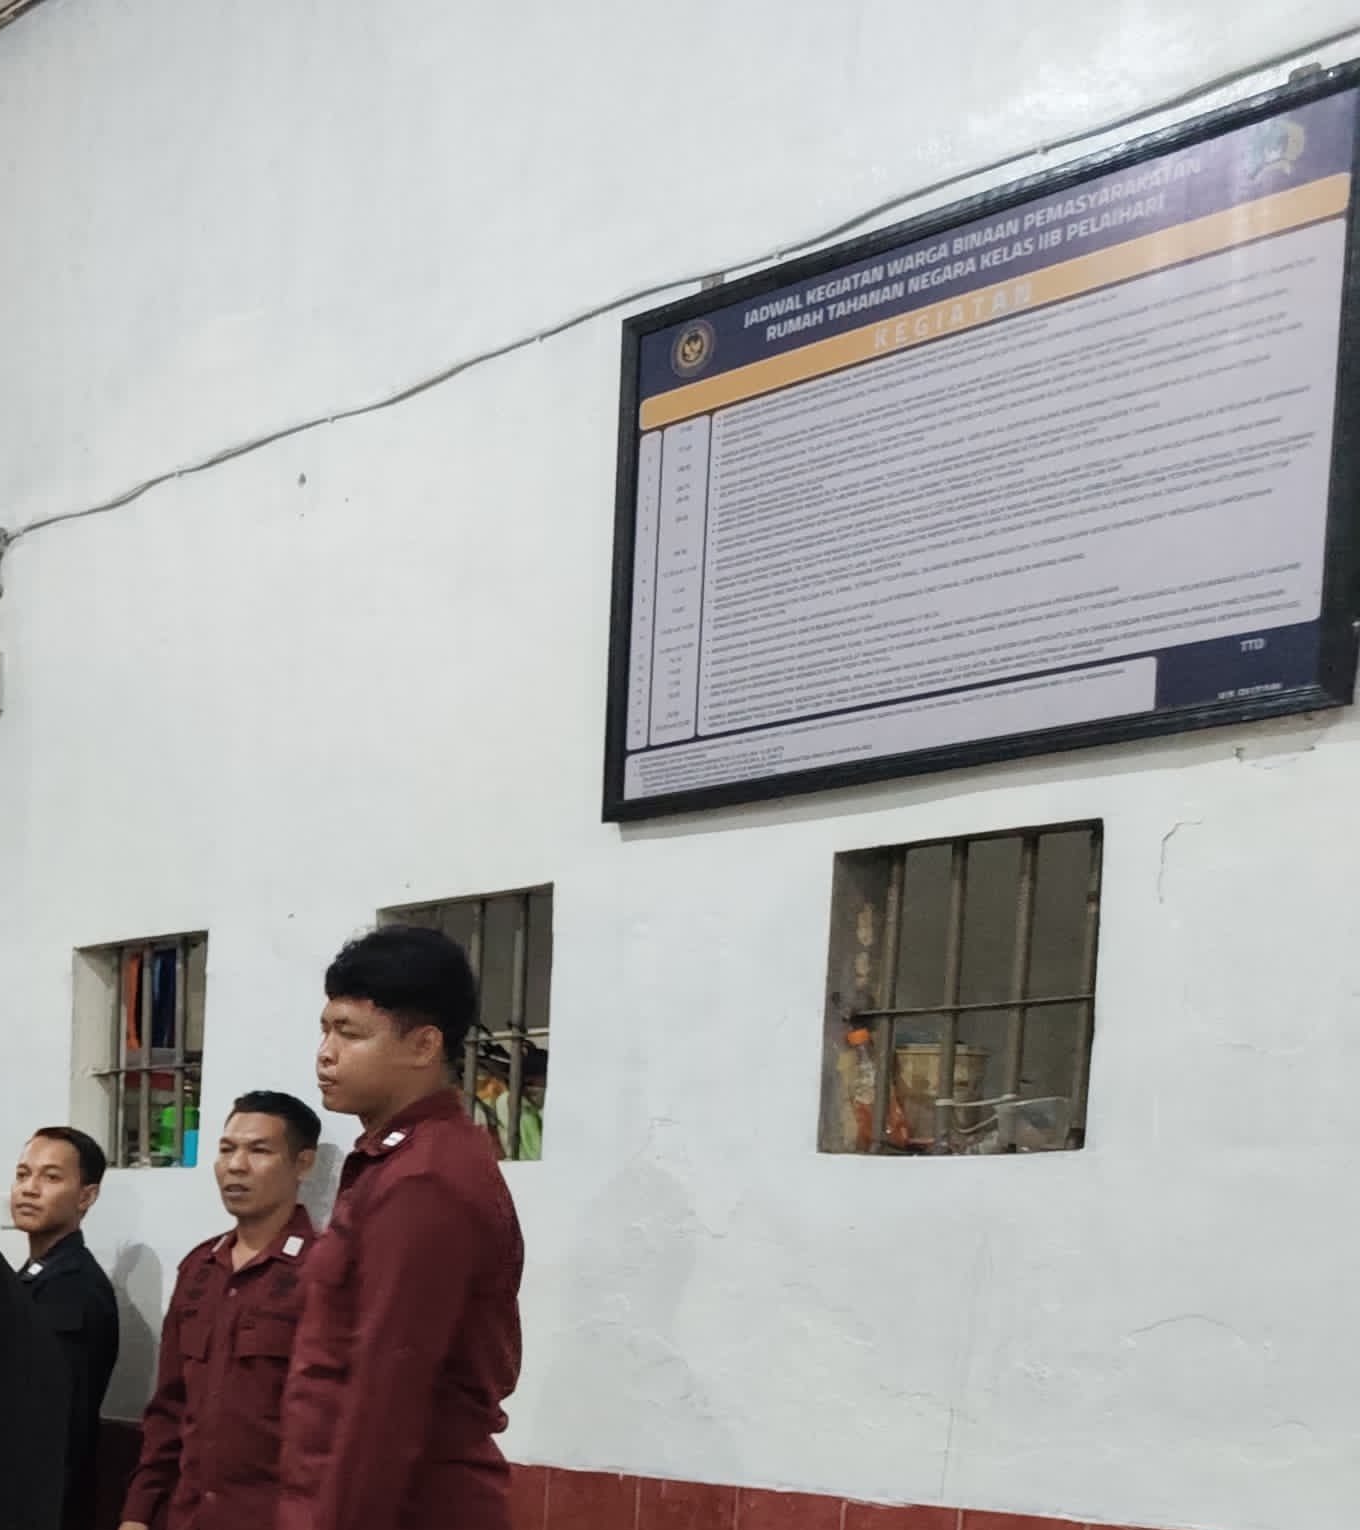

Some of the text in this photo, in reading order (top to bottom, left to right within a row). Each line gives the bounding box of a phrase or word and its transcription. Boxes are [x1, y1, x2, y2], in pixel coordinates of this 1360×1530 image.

[744, 157, 1202, 328] JADWAL KEGIATAN WARGA BINAAN PEMASYARAKATAN
[766, 191, 1166, 342] RUMAH TAHANAN NEGARA KELAS IIB PELAIHARI
[874, 282, 1031, 349] KEGIATAN
